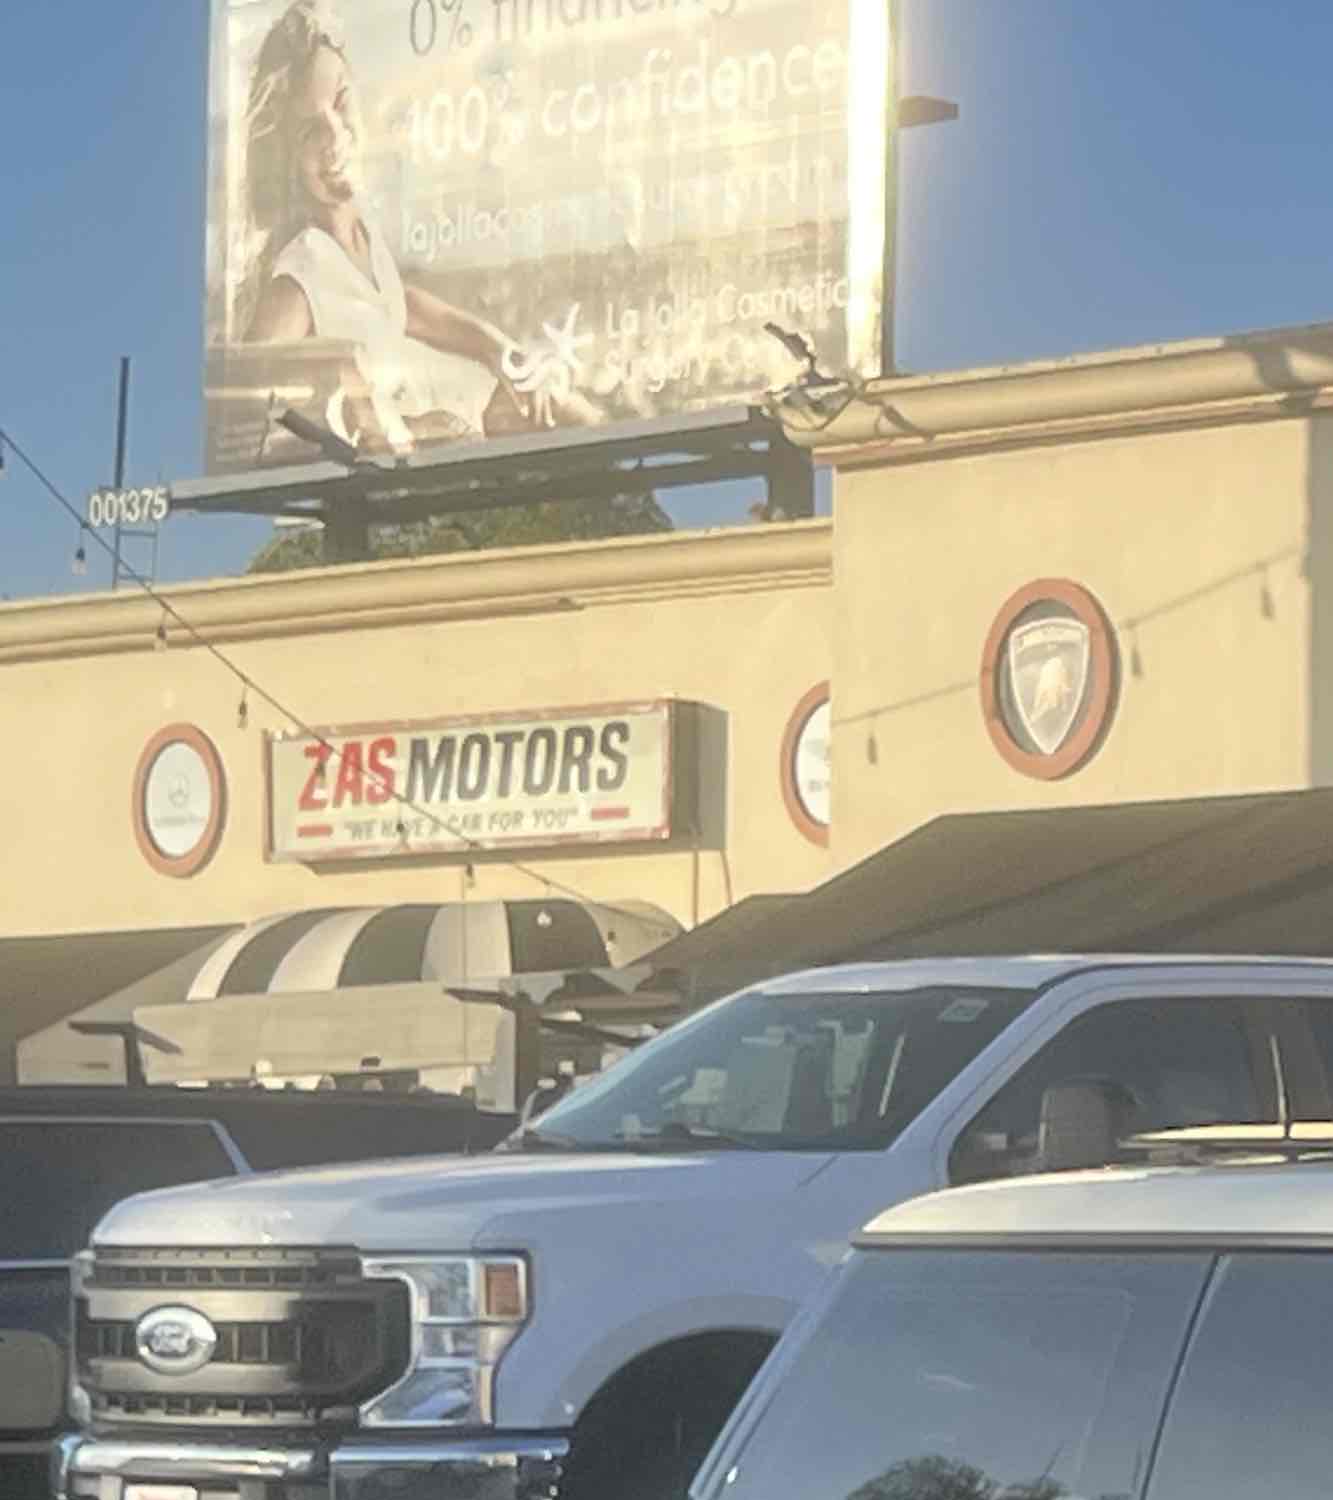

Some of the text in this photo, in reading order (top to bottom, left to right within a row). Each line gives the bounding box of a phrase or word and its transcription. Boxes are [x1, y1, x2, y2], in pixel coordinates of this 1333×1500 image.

[543, 37, 844, 137] confidence
[298, 721, 631, 812] ZAS MOTORS
